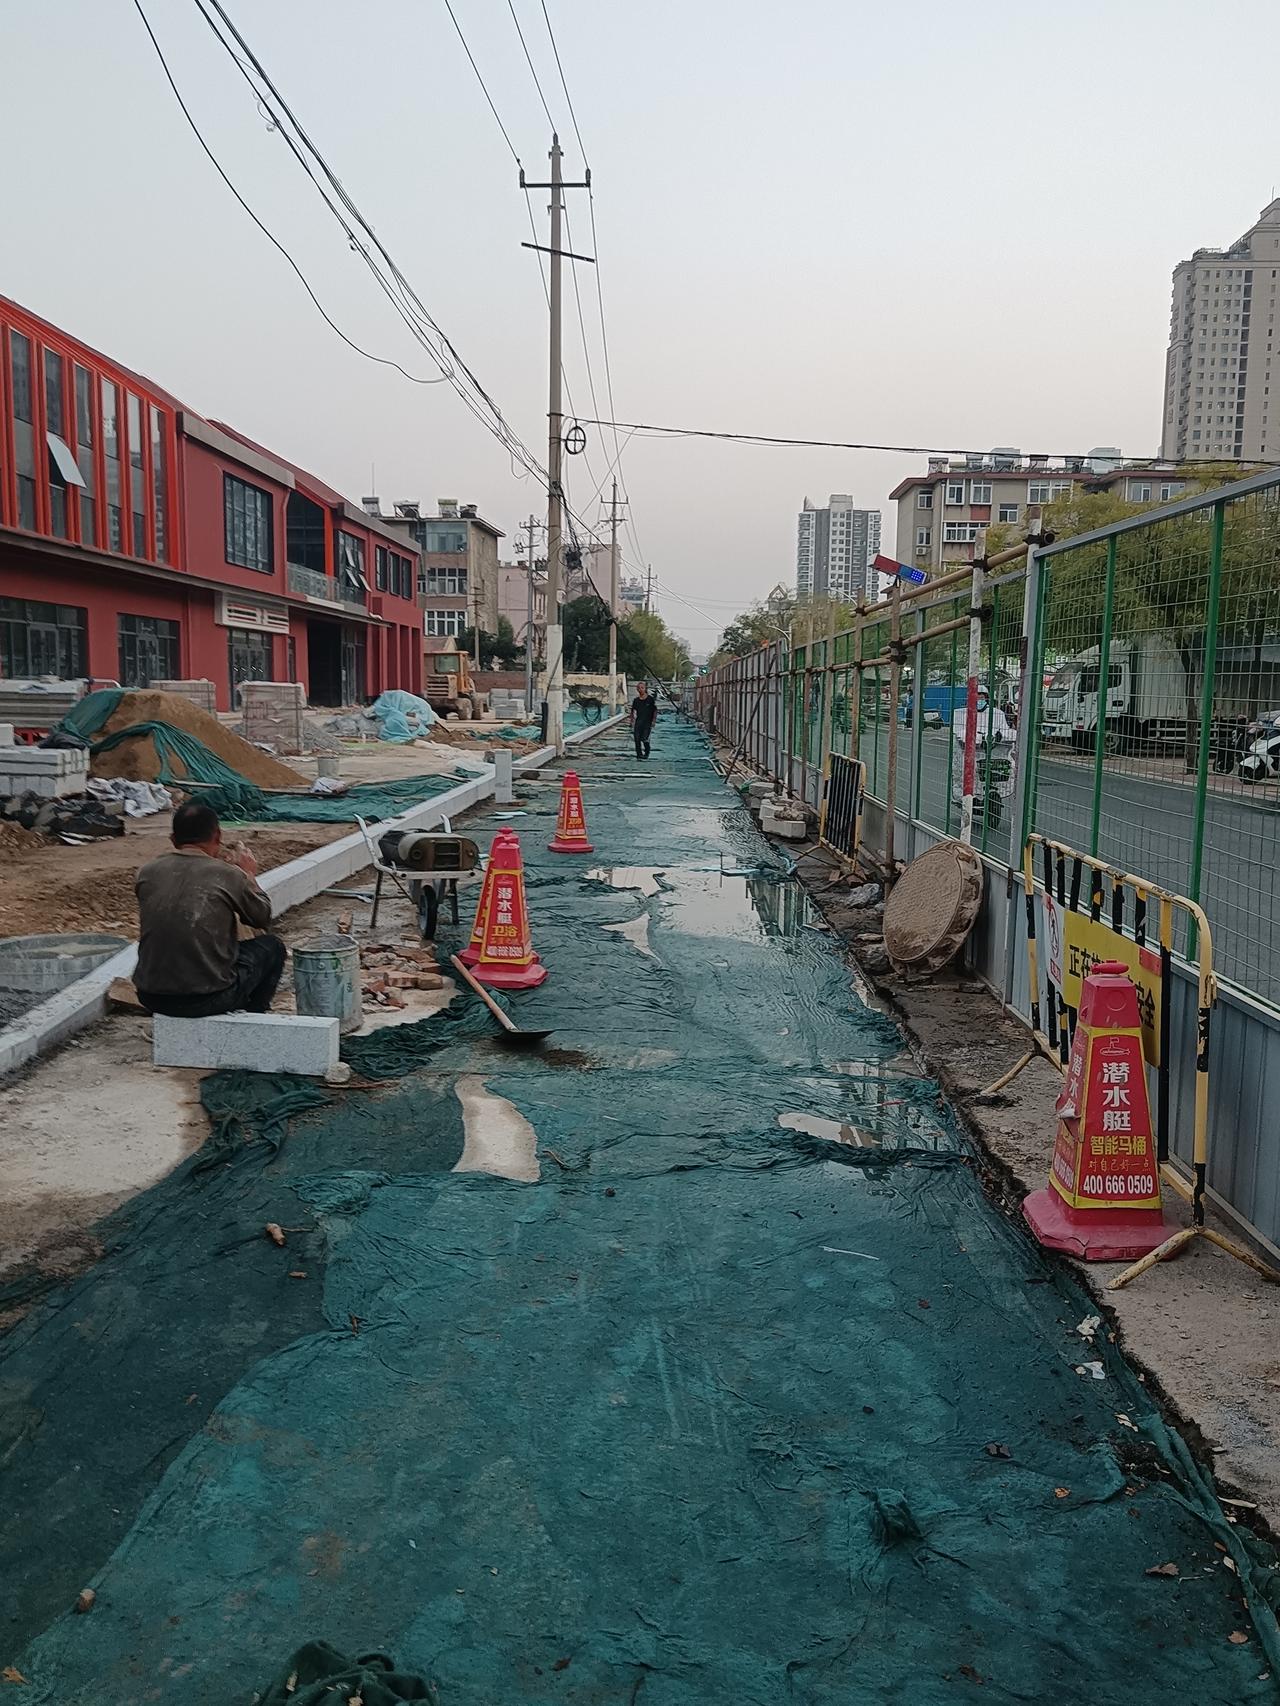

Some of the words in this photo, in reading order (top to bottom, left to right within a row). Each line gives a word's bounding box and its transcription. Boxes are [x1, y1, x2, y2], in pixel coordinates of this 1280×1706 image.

[492, 925, 518, 937] 卫浴
[1102, 1062, 1131, 1131] 潜水艇
[1090, 1135, 1147, 1155] 智能马桶
[1083, 1175, 1103, 1194] 400
[1105, 1175, 1126, 1194] 666
[1127, 1175, 1153, 1194] 0509
